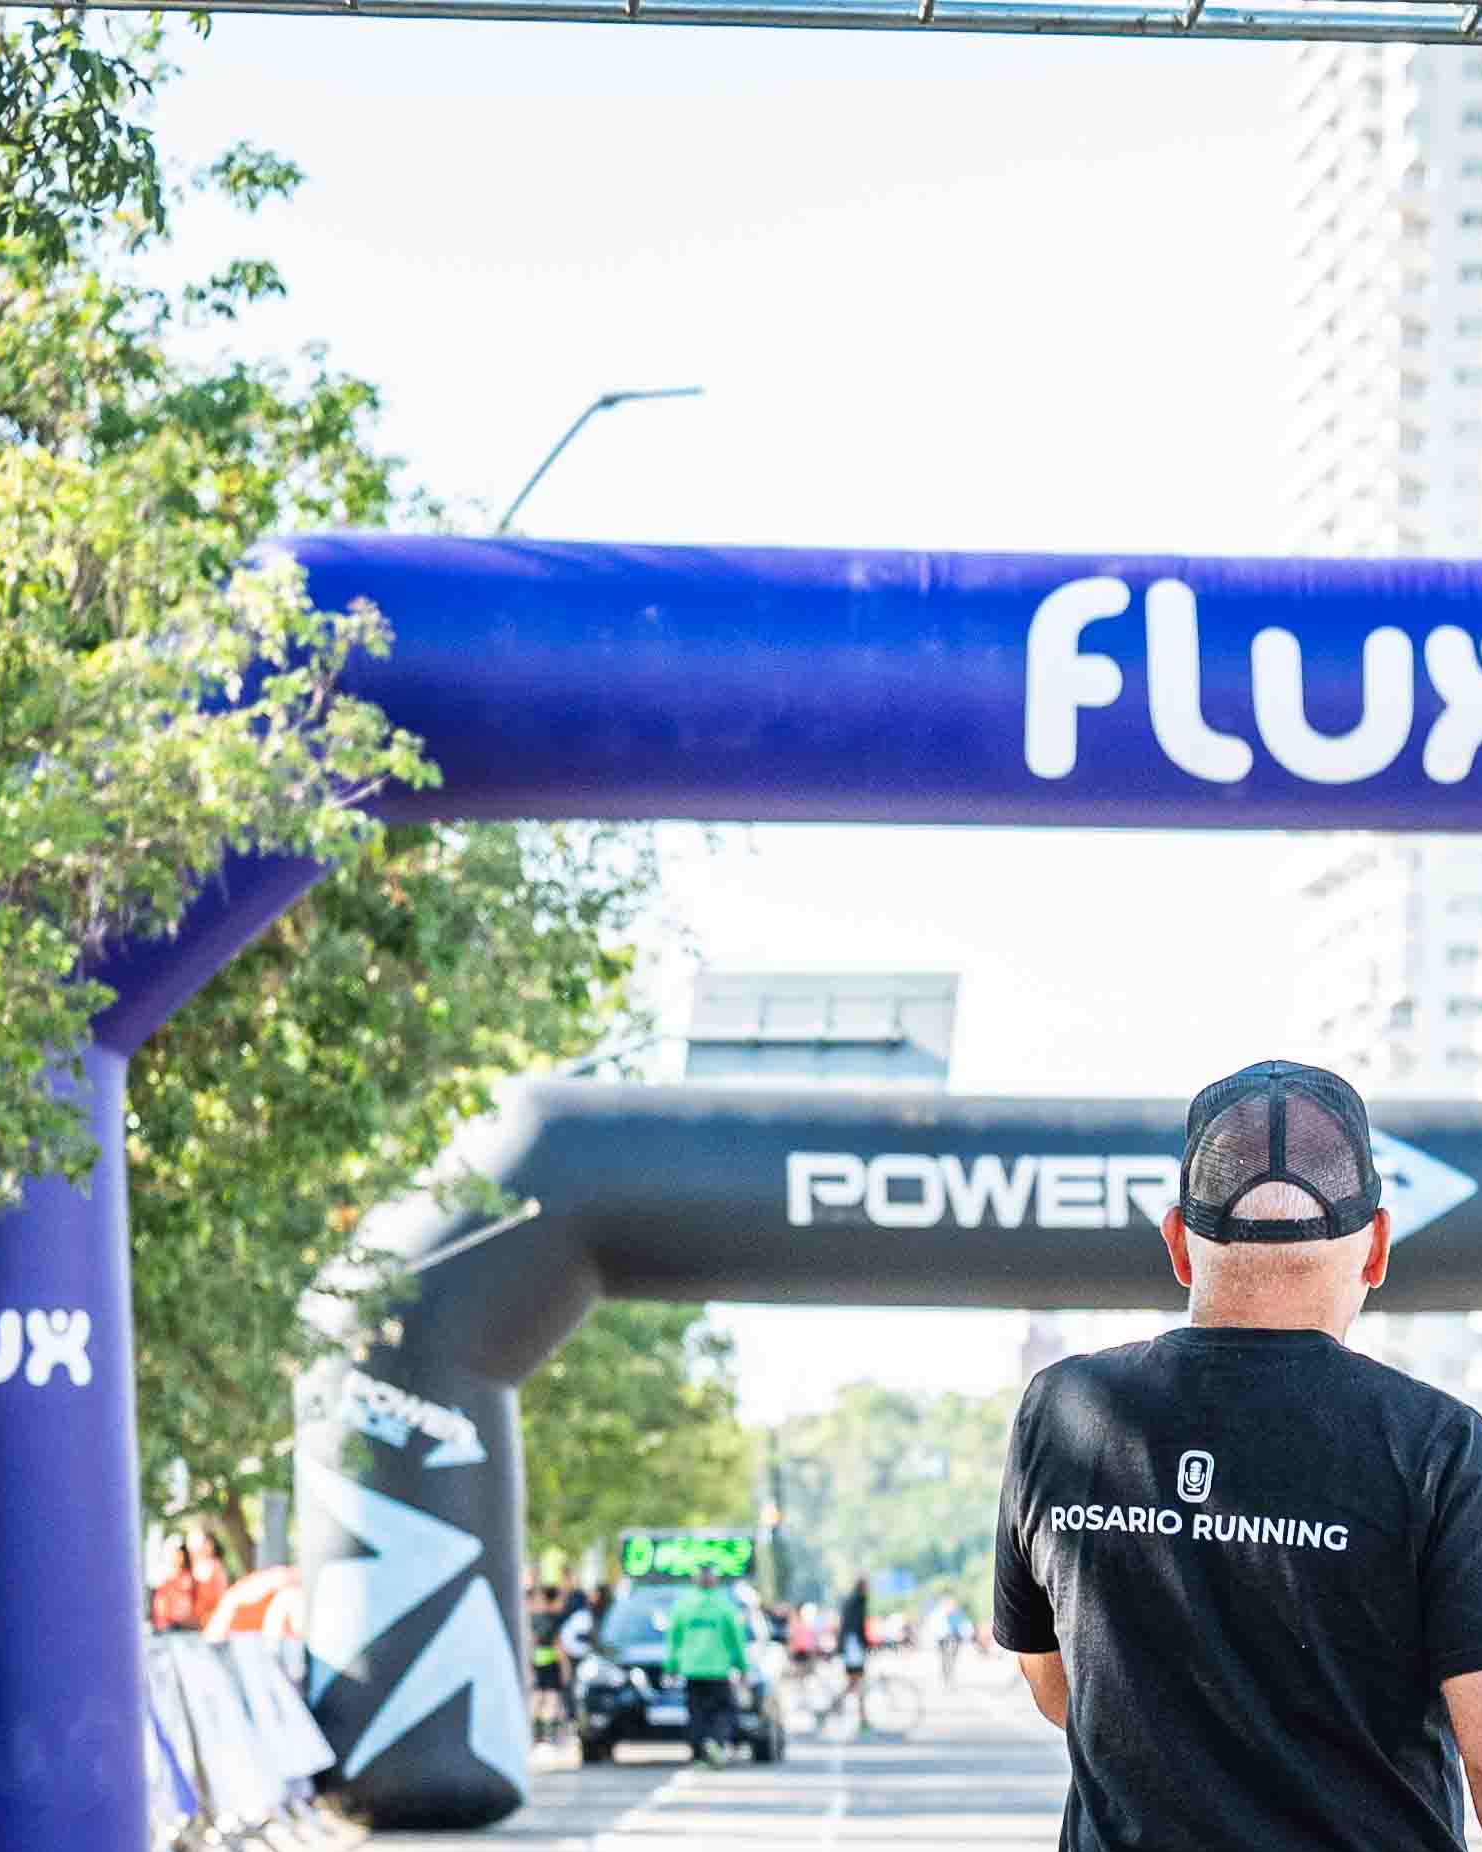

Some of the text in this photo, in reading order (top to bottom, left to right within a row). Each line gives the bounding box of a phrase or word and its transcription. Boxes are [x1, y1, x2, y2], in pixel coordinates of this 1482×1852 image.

[786, 1152, 1182, 1229] POWER
[1050, 1504, 1349, 1551] ROSARIO RUNNING
